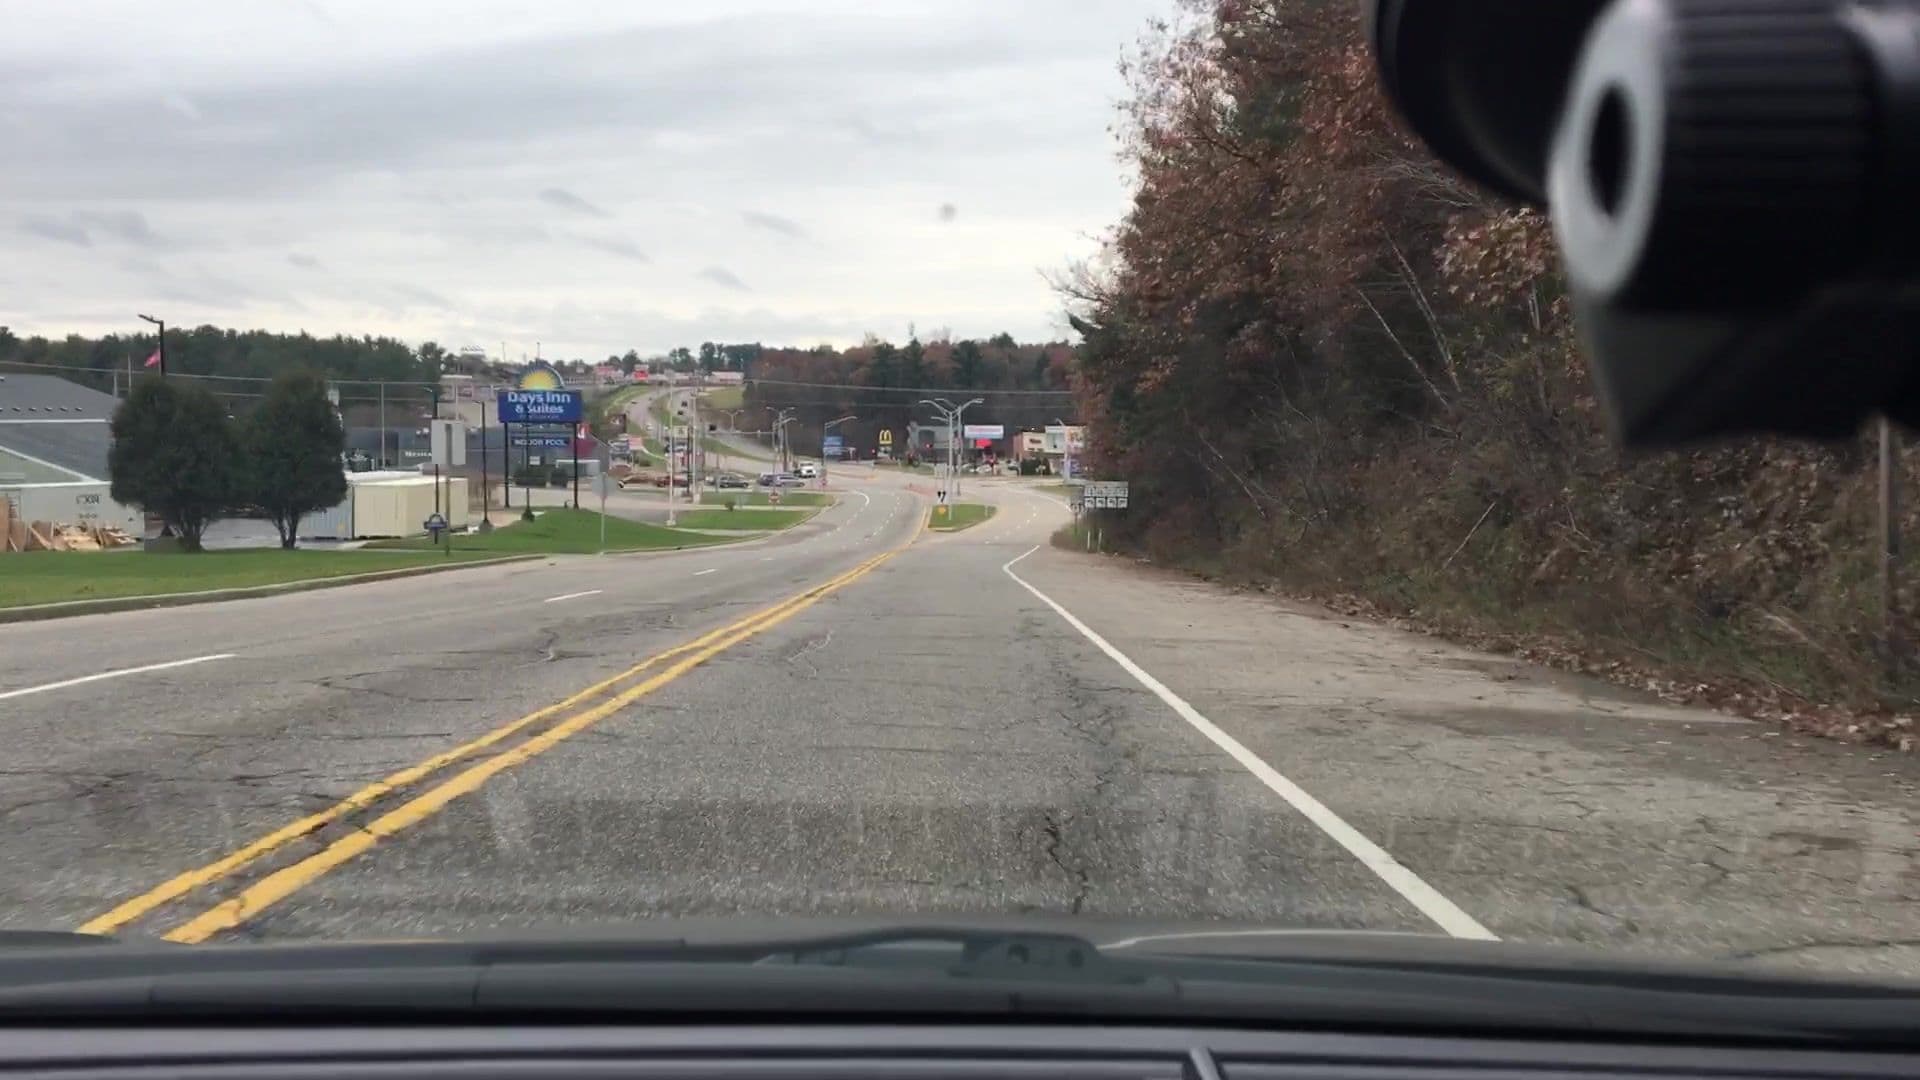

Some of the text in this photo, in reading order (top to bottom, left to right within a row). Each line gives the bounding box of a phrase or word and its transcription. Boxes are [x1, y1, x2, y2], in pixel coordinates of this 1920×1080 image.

[508, 391, 571, 405] Days Inn
[515, 403, 565, 414] & Suites
